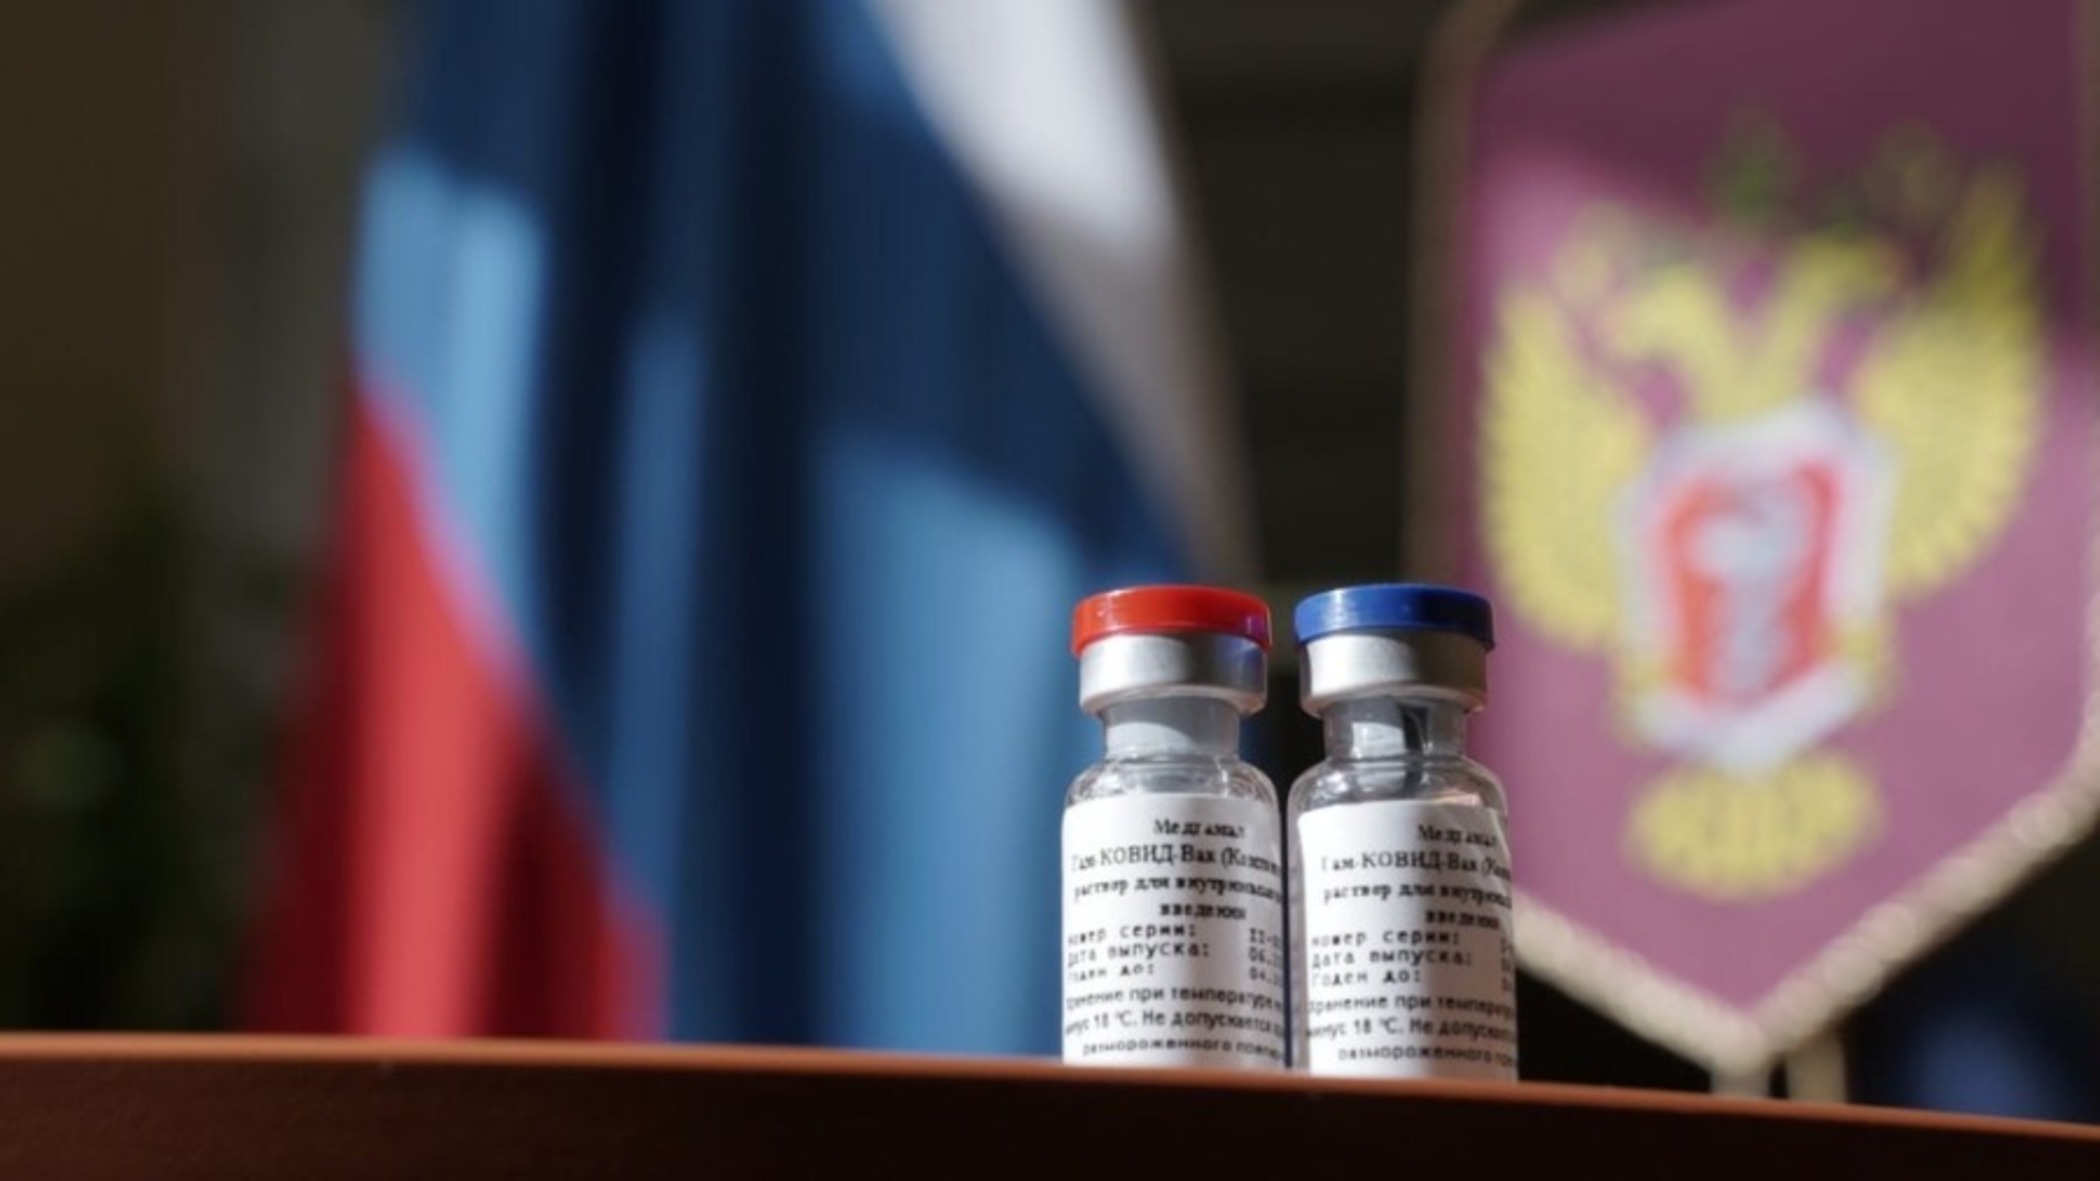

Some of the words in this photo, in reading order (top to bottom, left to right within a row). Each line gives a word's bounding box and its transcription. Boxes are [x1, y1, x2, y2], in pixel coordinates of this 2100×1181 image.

[1075, 877, 1128, 902] раствор
[1134, 876, 1169, 891] для
[1324, 884, 1392, 904] раствор
[1397, 883, 1435, 897] для
[1119, 923, 1196, 943] серии:
[1383, 930, 1460, 946] серии:
[1108, 942, 1210, 961] выпуска:
[1369, 949, 1473, 967] выпуска:
[1383, 969, 1422, 984] до:
[1129, 986, 1165, 1004] при
[1394, 995, 1432, 1010] при
[1142, 1009, 1166, 1026] Не
[1353, 1018, 1372, 1034] 18
[1409, 1018, 1435, 1034] Не
